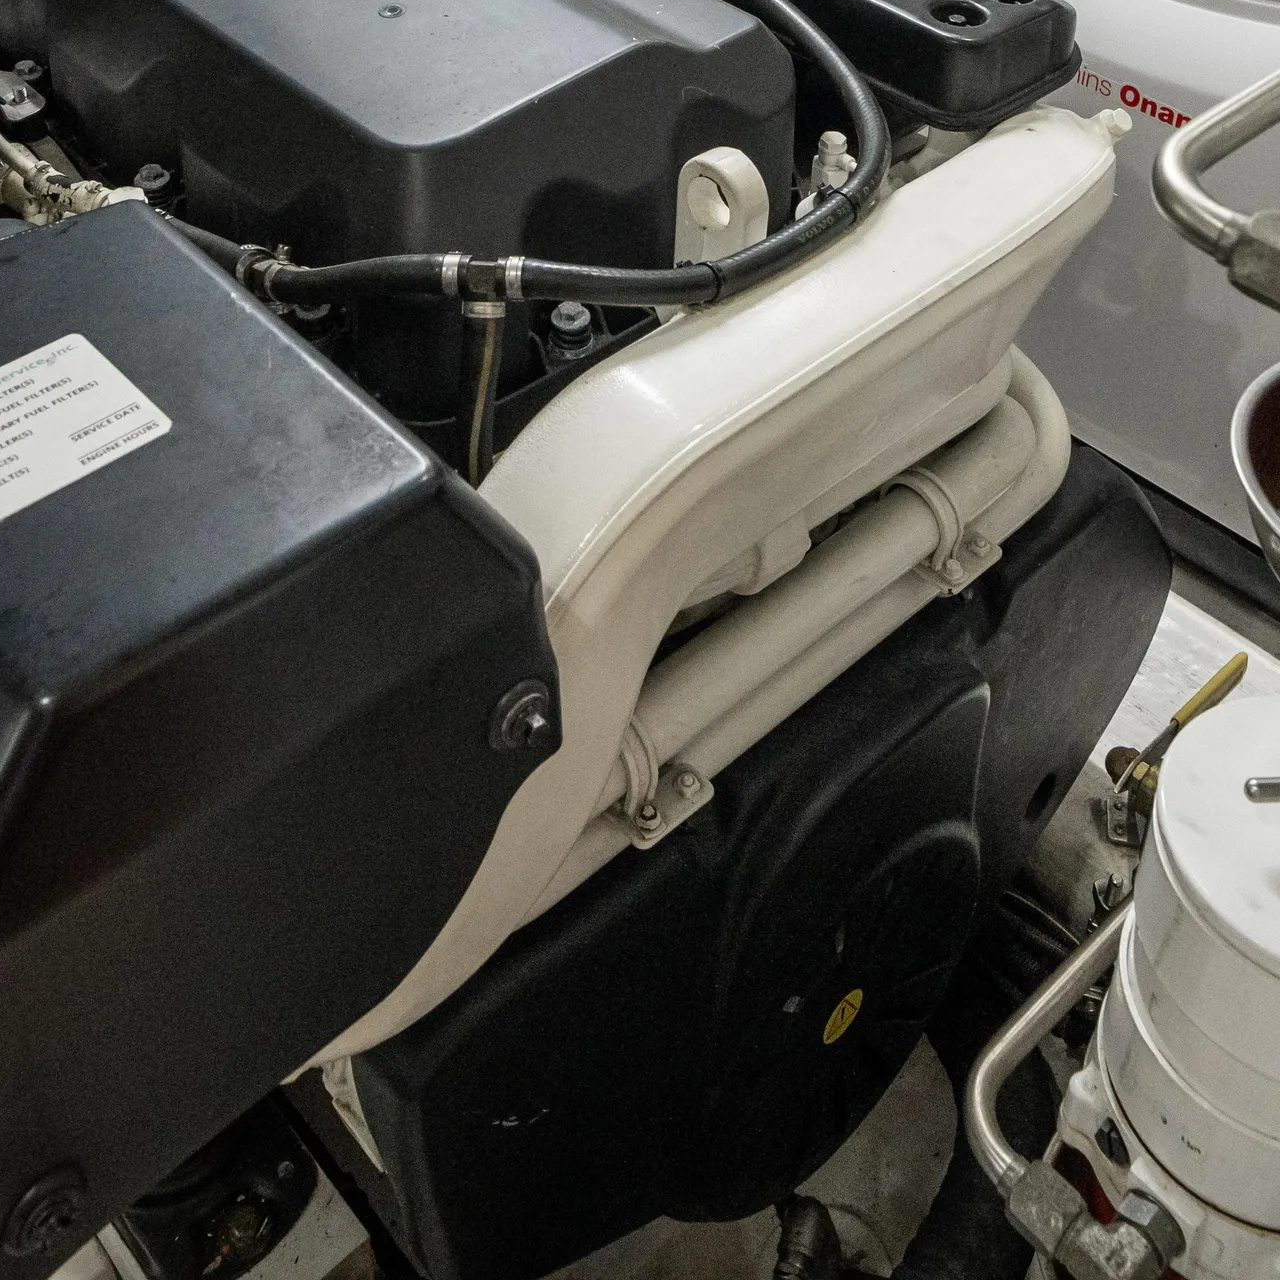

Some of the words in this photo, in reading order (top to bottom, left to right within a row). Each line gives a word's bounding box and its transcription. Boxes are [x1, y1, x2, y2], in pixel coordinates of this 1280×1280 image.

[23, 403, 50, 420] FUEL
[52, 380, 99, 407] FILTER(S)
[24, 376, 72, 403] FILTER(S)
[70, 419, 114, 443] SERVICE
[114, 404, 141, 421] DATE
[80, 442, 122, 466] ENGINE
[122, 421, 160, 444] HOURS
